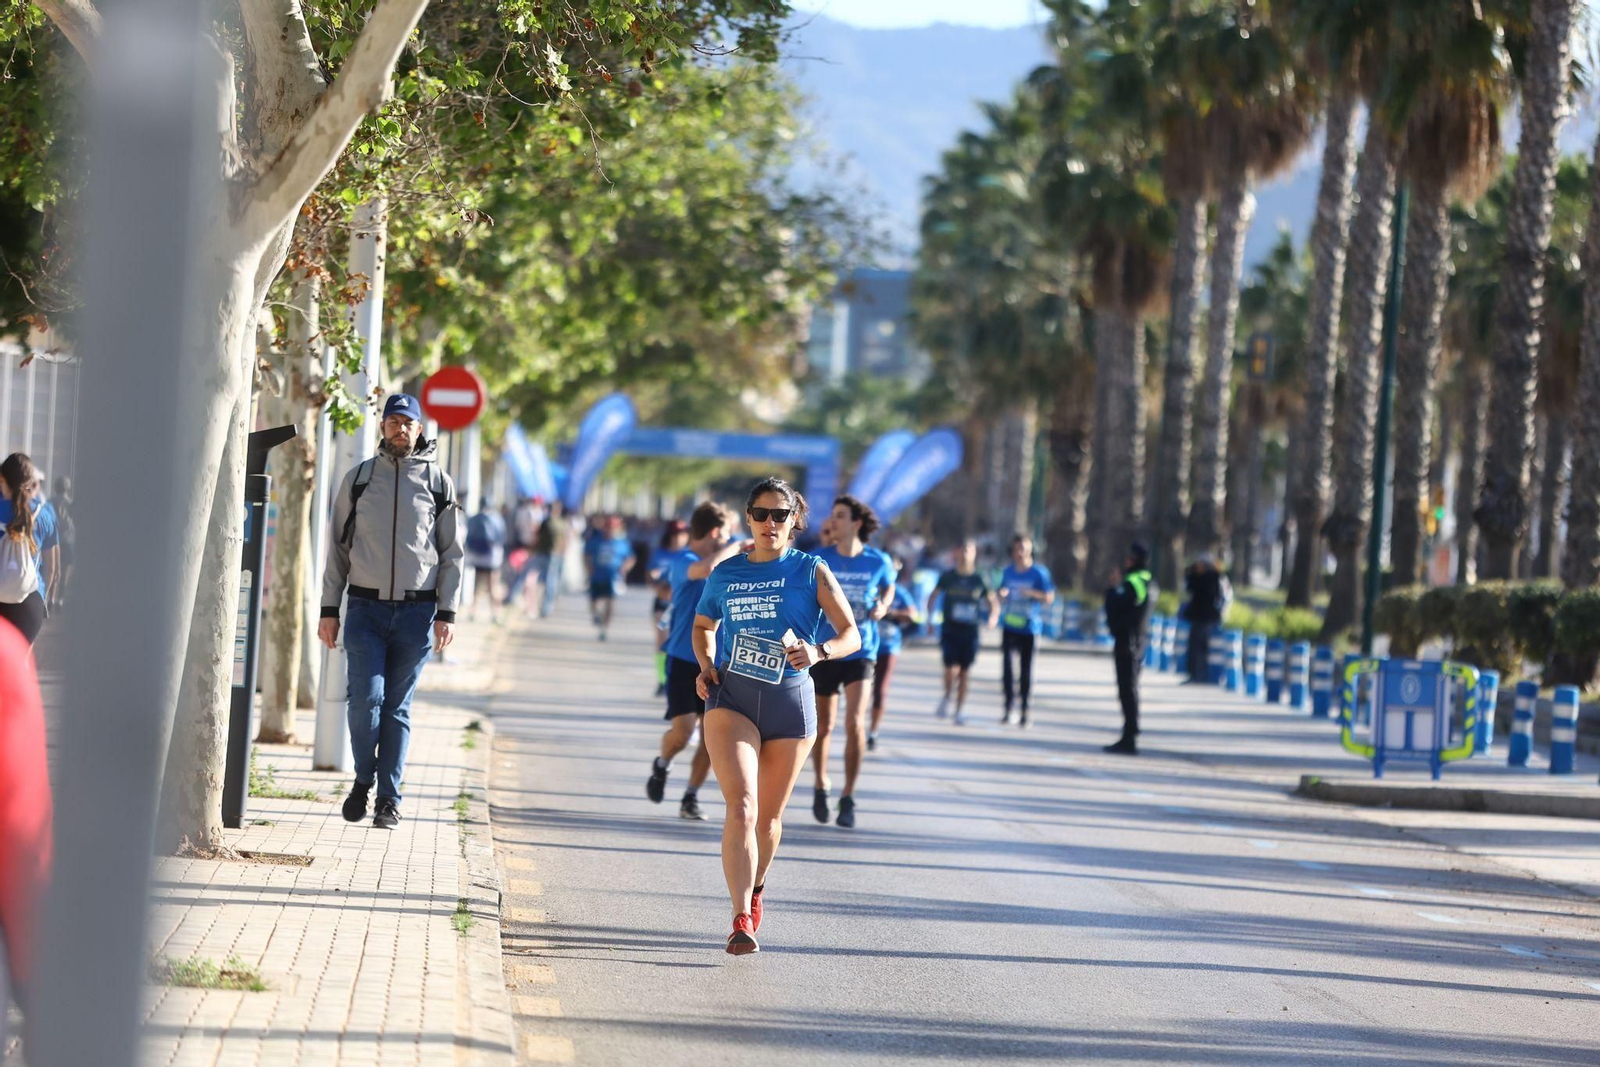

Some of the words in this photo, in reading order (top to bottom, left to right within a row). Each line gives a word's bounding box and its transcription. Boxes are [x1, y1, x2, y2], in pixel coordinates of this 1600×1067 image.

[726, 577, 786, 592] mayoral
[726, 595, 780, 607] RUNNING
[731, 603, 775, 614] MAKES
[731, 611, 777, 621] FRIENDS
[738, 649, 779, 669] 2140
